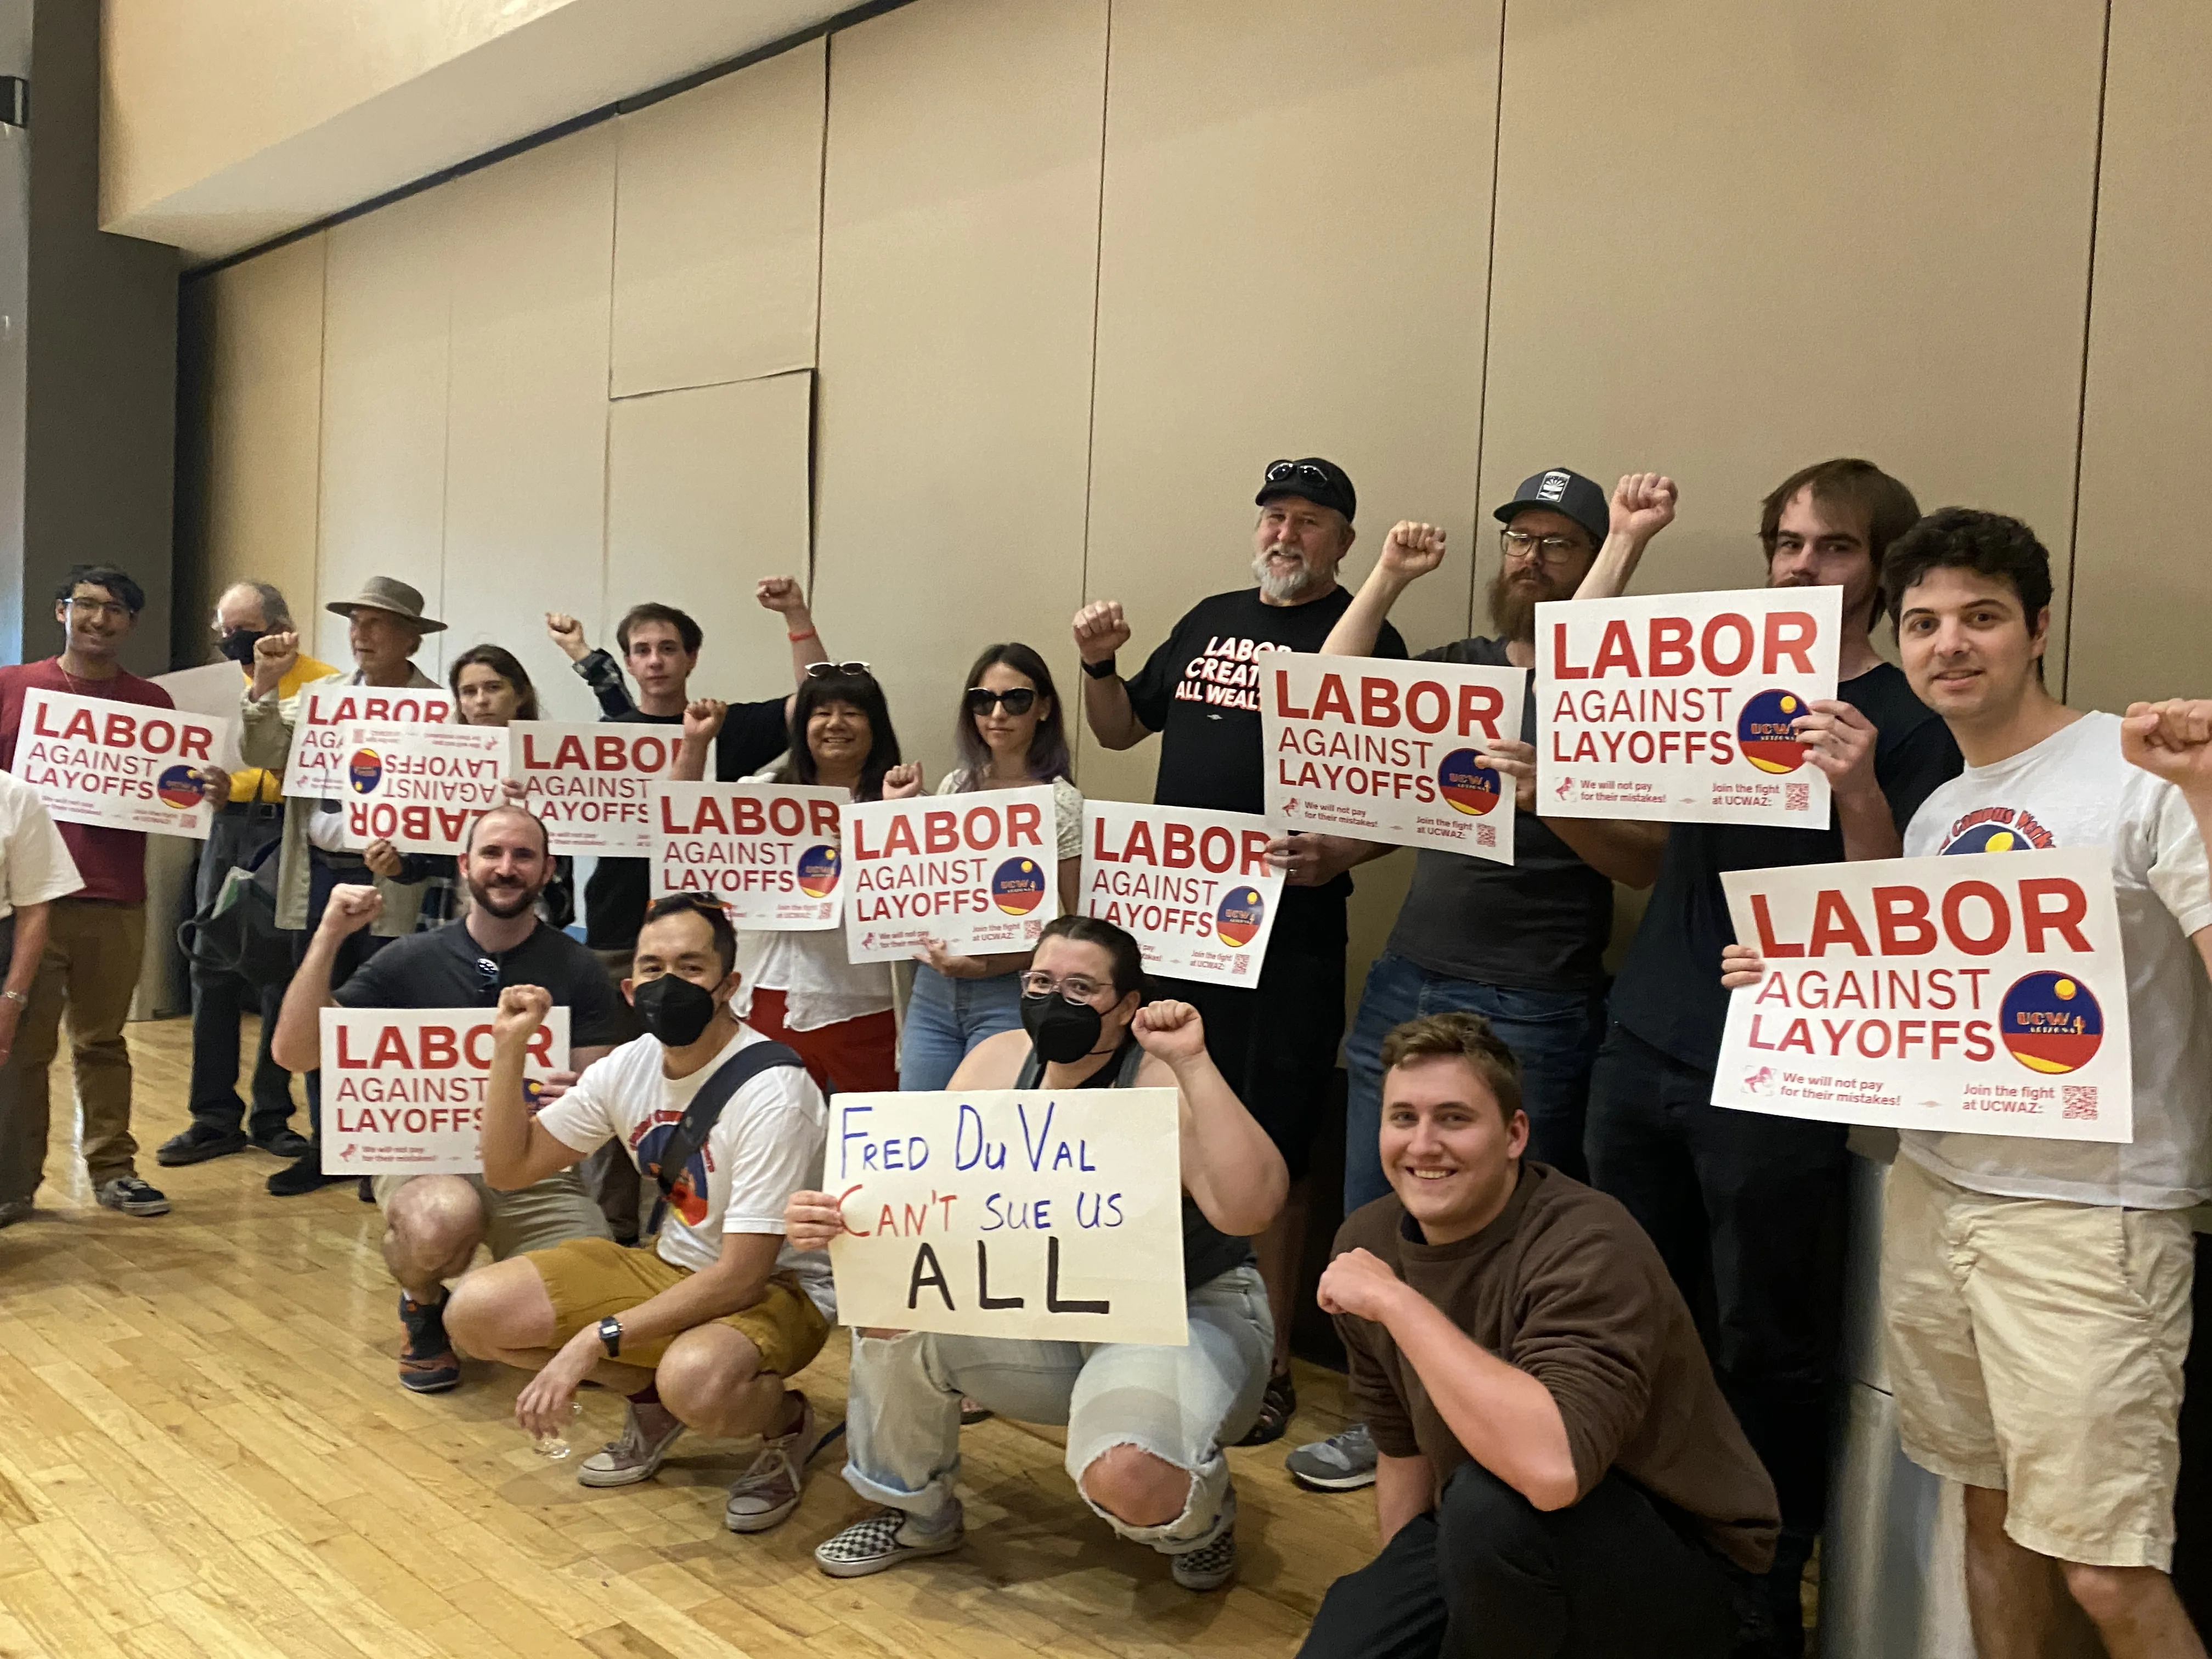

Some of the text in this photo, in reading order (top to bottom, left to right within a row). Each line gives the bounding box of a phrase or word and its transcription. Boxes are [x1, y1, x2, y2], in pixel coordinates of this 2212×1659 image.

[1203, 636, 1292, 664] LABO
[1553, 611, 1818, 680] LABOR
[1185, 657, 1260, 689] CREAT
[1175, 681, 1261, 712] ALL WEAL
[1276, 670, 1504, 739] LABOR
[1553, 687, 1732, 723] AGAINST
[34, 702, 212, 760] LABOR
[1278, 726, 1434, 769] AGAINST
[1553, 731, 1734, 765] LAYOFFS
[28, 742, 157, 777] AGAINST
[385, 754, 498, 779] LAYOFFS
[523, 734, 682, 773] LABO
[25, 765, 154, 800] LAYOFFS
[382, 778, 495, 803] AGAINST
[526, 776, 652, 798] AGAINST
[1279, 759, 1436, 803] LAYOFFS
[1580, 780, 1652, 792] We will not pay
[1581, 792, 1594, 800] for
[1595, 793, 1618, 801] their
[1712, 783, 1780, 795] Join the fight
[661, 796, 840, 836] LABOR
[1305, 801, 1318, 809] We
[1351, 809, 1365, 817] pay
[1712, 796, 1722, 805] at
[854, 803, 1043, 861] LABOR
[1417, 816, 1472, 831] Join the fight
[663, 842, 794, 865] AGAINST
[1094, 817, 1271, 877] LABOR
[664, 869, 794, 892] LAYOFFS
[856, 858, 987, 893] AGAINST
[1092, 869, 1218, 906] AGAINST
[856, 888, 988, 922] LAYOFFS
[1750, 877, 2094, 958] LABOR
[1755, 968, 1991, 1010] AGAINST
[2017, 1012, 2070, 1025] UCW
[1748, 1013, 1995, 1062] LAYOFFS
[336, 1077, 489, 1103] AGAINST
[1780, 1086, 1902, 1106] for their mistakes!
[1782, 1071, 1884, 1093] We will not pay
[1963, 1083, 2055, 1101] Join the fight
[1962, 1099, 2044, 1114] at UCWAZ:
[841, 1106, 929, 1179] FRED
[838, 1184, 957, 1237] CAN'T
[908, 1235, 1110, 1314] ALL
